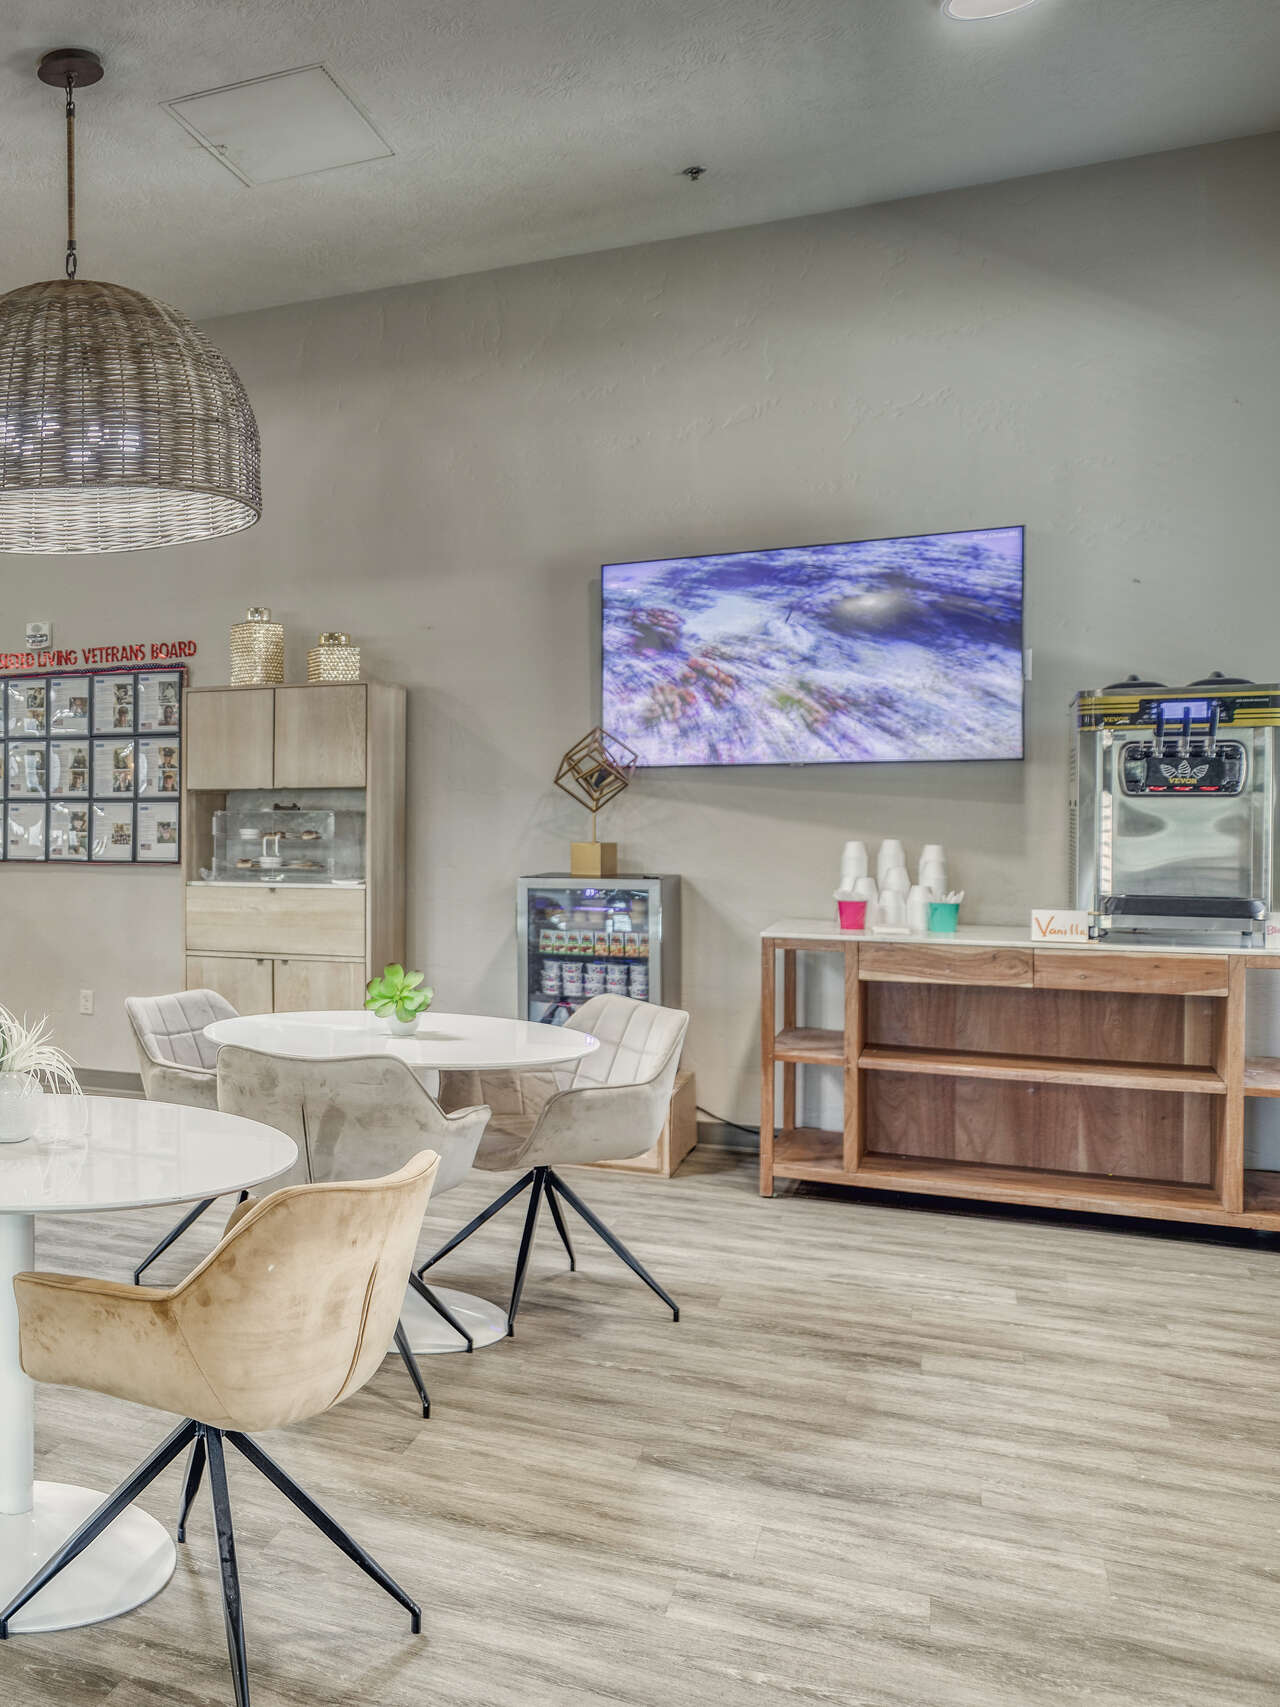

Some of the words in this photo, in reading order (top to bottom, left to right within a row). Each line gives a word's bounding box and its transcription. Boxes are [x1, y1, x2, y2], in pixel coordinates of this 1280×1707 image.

[37, 649, 78, 667] LIVING
[82, 643, 146, 664] VETERANS
[151, 640, 197, 660] BOARD
[1034, 915, 1088, 937] Vanilla
